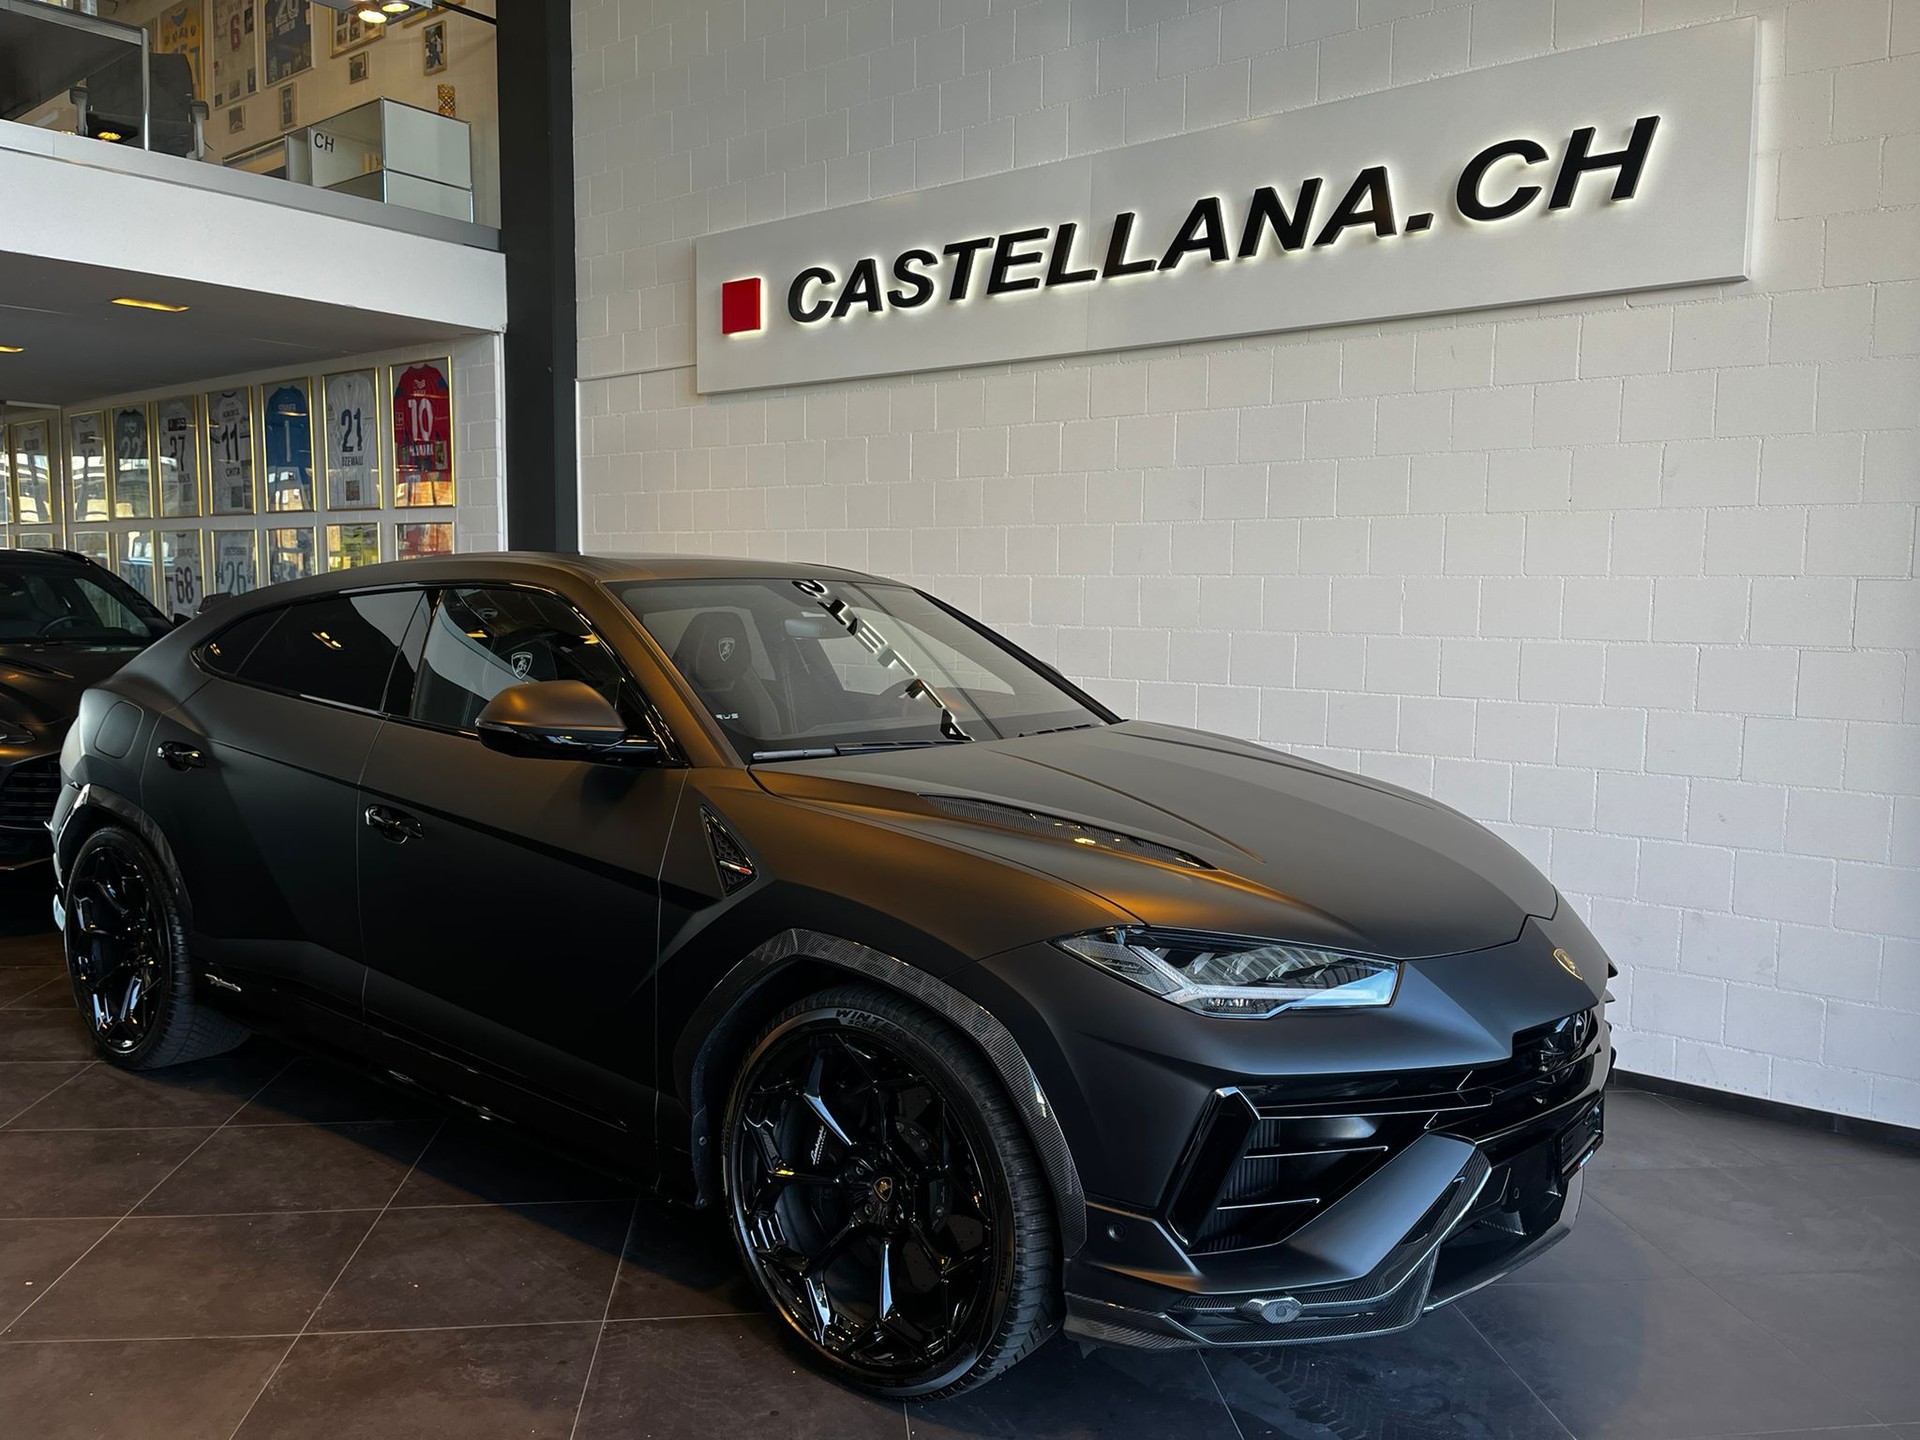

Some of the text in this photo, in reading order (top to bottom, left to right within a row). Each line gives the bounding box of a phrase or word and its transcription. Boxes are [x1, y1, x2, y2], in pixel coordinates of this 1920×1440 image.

[314, 132, 334, 153] CH
[788, 115, 1660, 323] CASTELLANA.CH
[341, 407, 363, 453] 21
[408, 397, 434, 442] 10
[170, 435, 186, 472] 27
[221, 423, 239, 464] 11
[175, 566, 194, 605] 68
